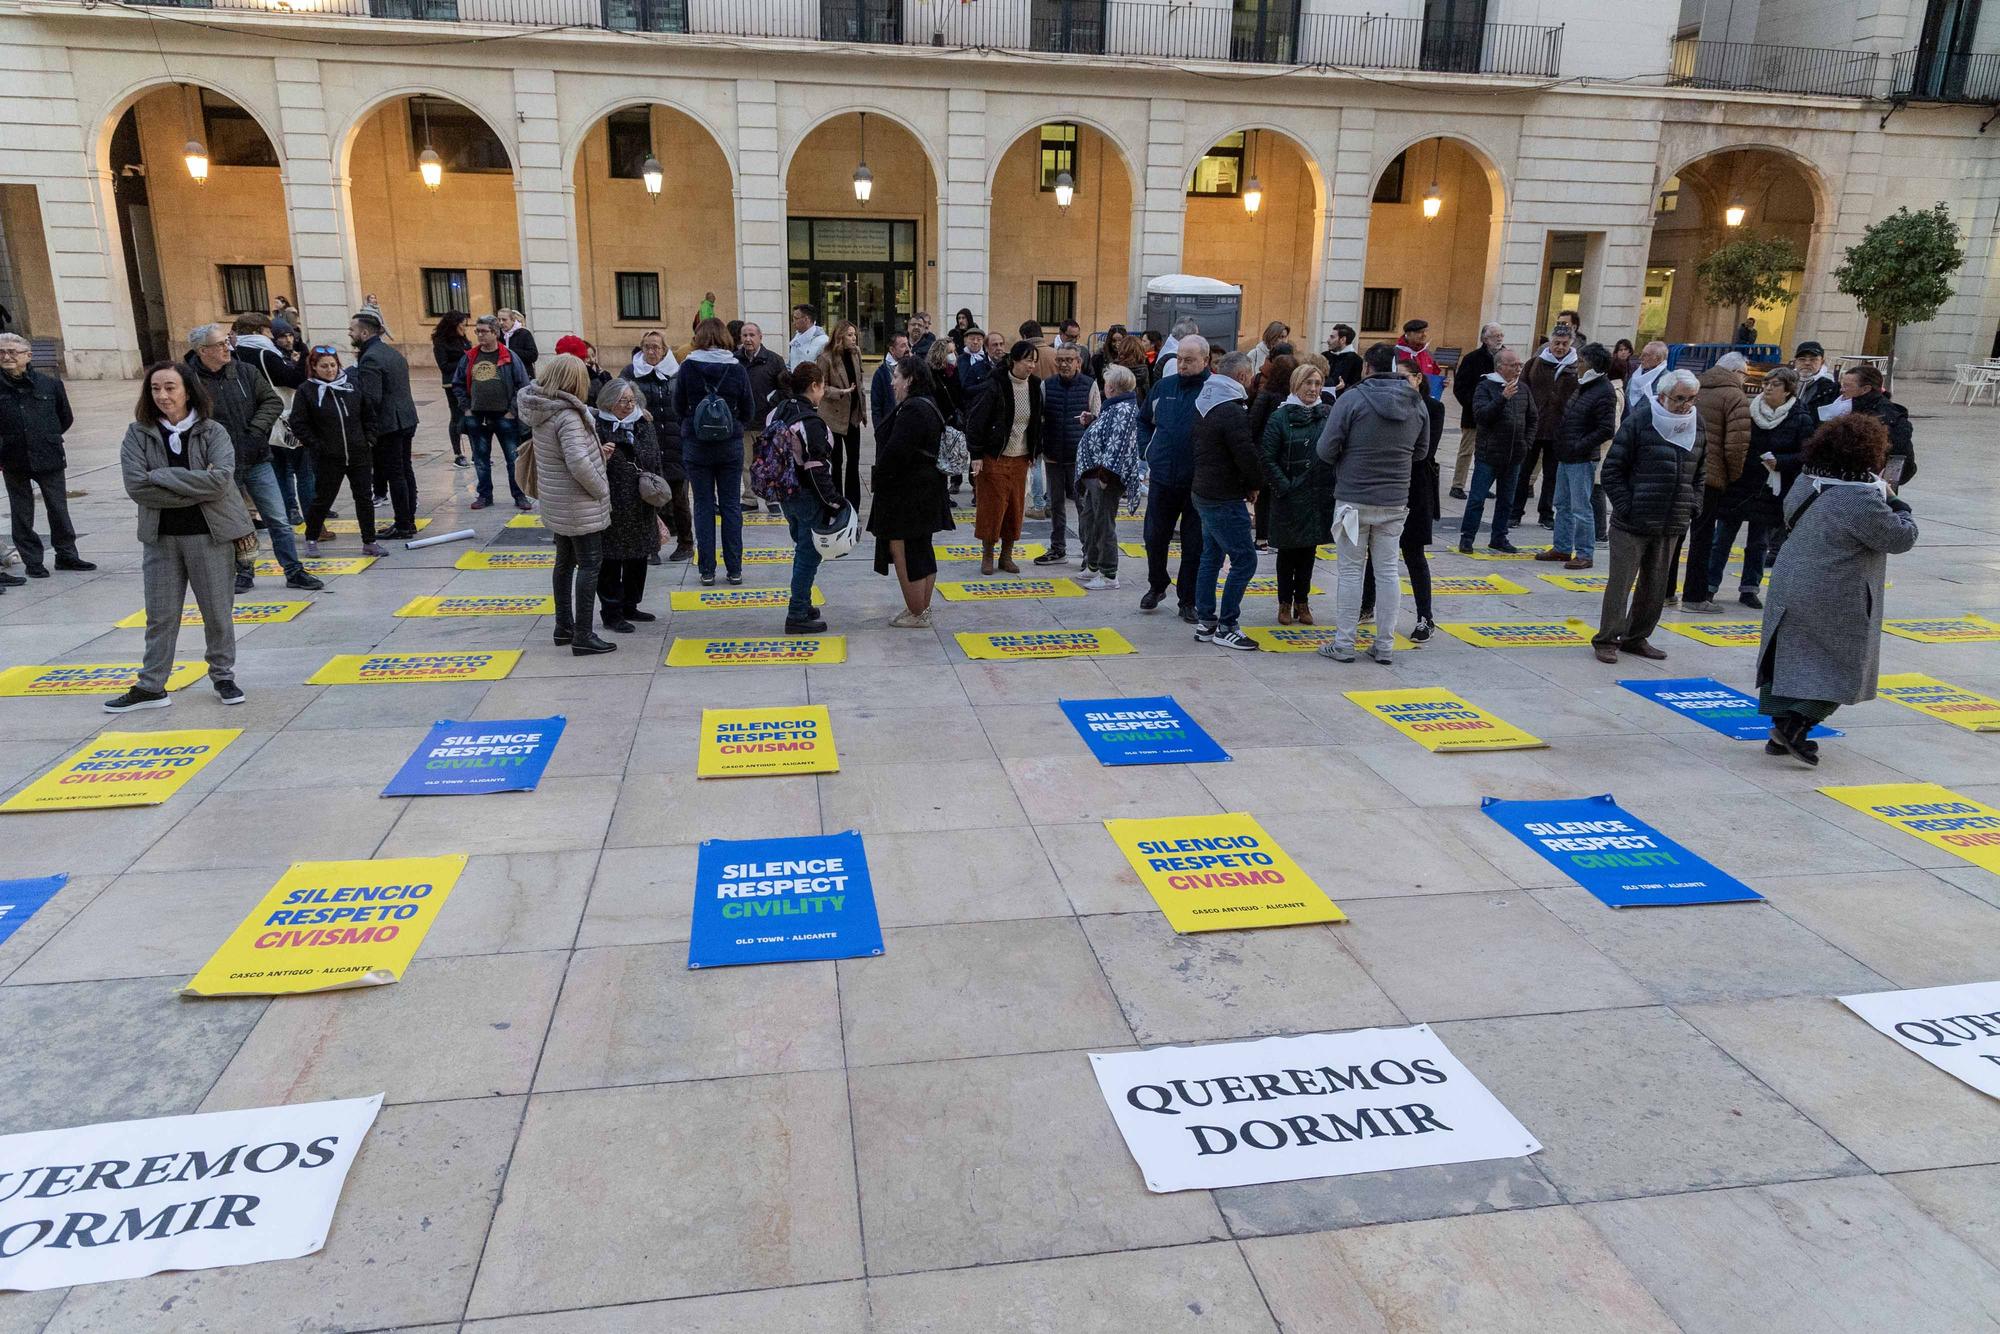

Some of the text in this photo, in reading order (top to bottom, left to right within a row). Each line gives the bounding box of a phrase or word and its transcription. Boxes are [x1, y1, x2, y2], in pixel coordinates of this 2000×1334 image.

[707, 640, 820, 648] SILENCIO
[988, 633, 1094, 642] SILENCIO
[992, 638, 1098, 647] RESPETO
[705, 646, 819, 654] RESPETO
[1000, 644, 1100, 652] CIVISMO
[368, 655, 493, 664] SILENCIO
[708, 652, 814, 660] CIVISMO
[359, 661, 488, 671] RESPETO
[359, 667, 477, 677] CIVISMO
[1654, 691, 1737, 700] SILENCE
[1375, 701, 1464, 713] SILENCIO
[1669, 699, 1757, 710] RESPECT
[1084, 710, 1172, 722] SILENCE
[1390, 711, 1481, 723] RESPETO
[717, 720, 817, 732] SILENCIO
[1088, 719, 1181, 732] RESPECT
[1410, 720, 1495, 733] CIVISMO
[440, 733, 543, 746] SILENCE
[716, 730, 817, 744] RESPETO
[1102, 730, 1187, 743] CIVILITY
[89, 745, 211, 760] SILENCIO
[428, 744, 540, 758] RESPECT
[720, 741, 815, 755] CIVISMO
[69, 757, 196, 772] RESPETO
[425, 756, 529, 770] CIVILITY
[59, 769, 176, 785] CIVISMO
[1871, 802, 1981, 817] SILENCIO
[1523, 820, 1636, 836] SILENCE
[1137, 835, 1259, 854] SILENCIO
[1539, 835, 1659, 852] RESPECT
[1148, 852, 1273, 873] RESPETO
[1570, 851, 1681, 870] CIVILITY
[722, 858, 844, 880] SILENCE
[1168, 869, 1286, 890] CIVISMO
[282, 883, 433, 905] SILENCIO
[717, 876, 849, 899] RESPECT
[722, 895, 846, 920] CIVILITY
[1221, 905, 1259, 914] ANTIGUO
[1266, 902, 1307, 911] ALICANTE
[264, 904, 419, 927] RESPETO
[254, 925, 400, 949] CIVISMO
[736, 932, 838, 945] OLD TOWN ALICANTE
[229, 965, 374, 980] CASCO ANTIGUO ALICANTE
[1127, 1058, 1448, 1115] QUEREMOS
[1185, 1102, 1454, 1156] DORMIR
